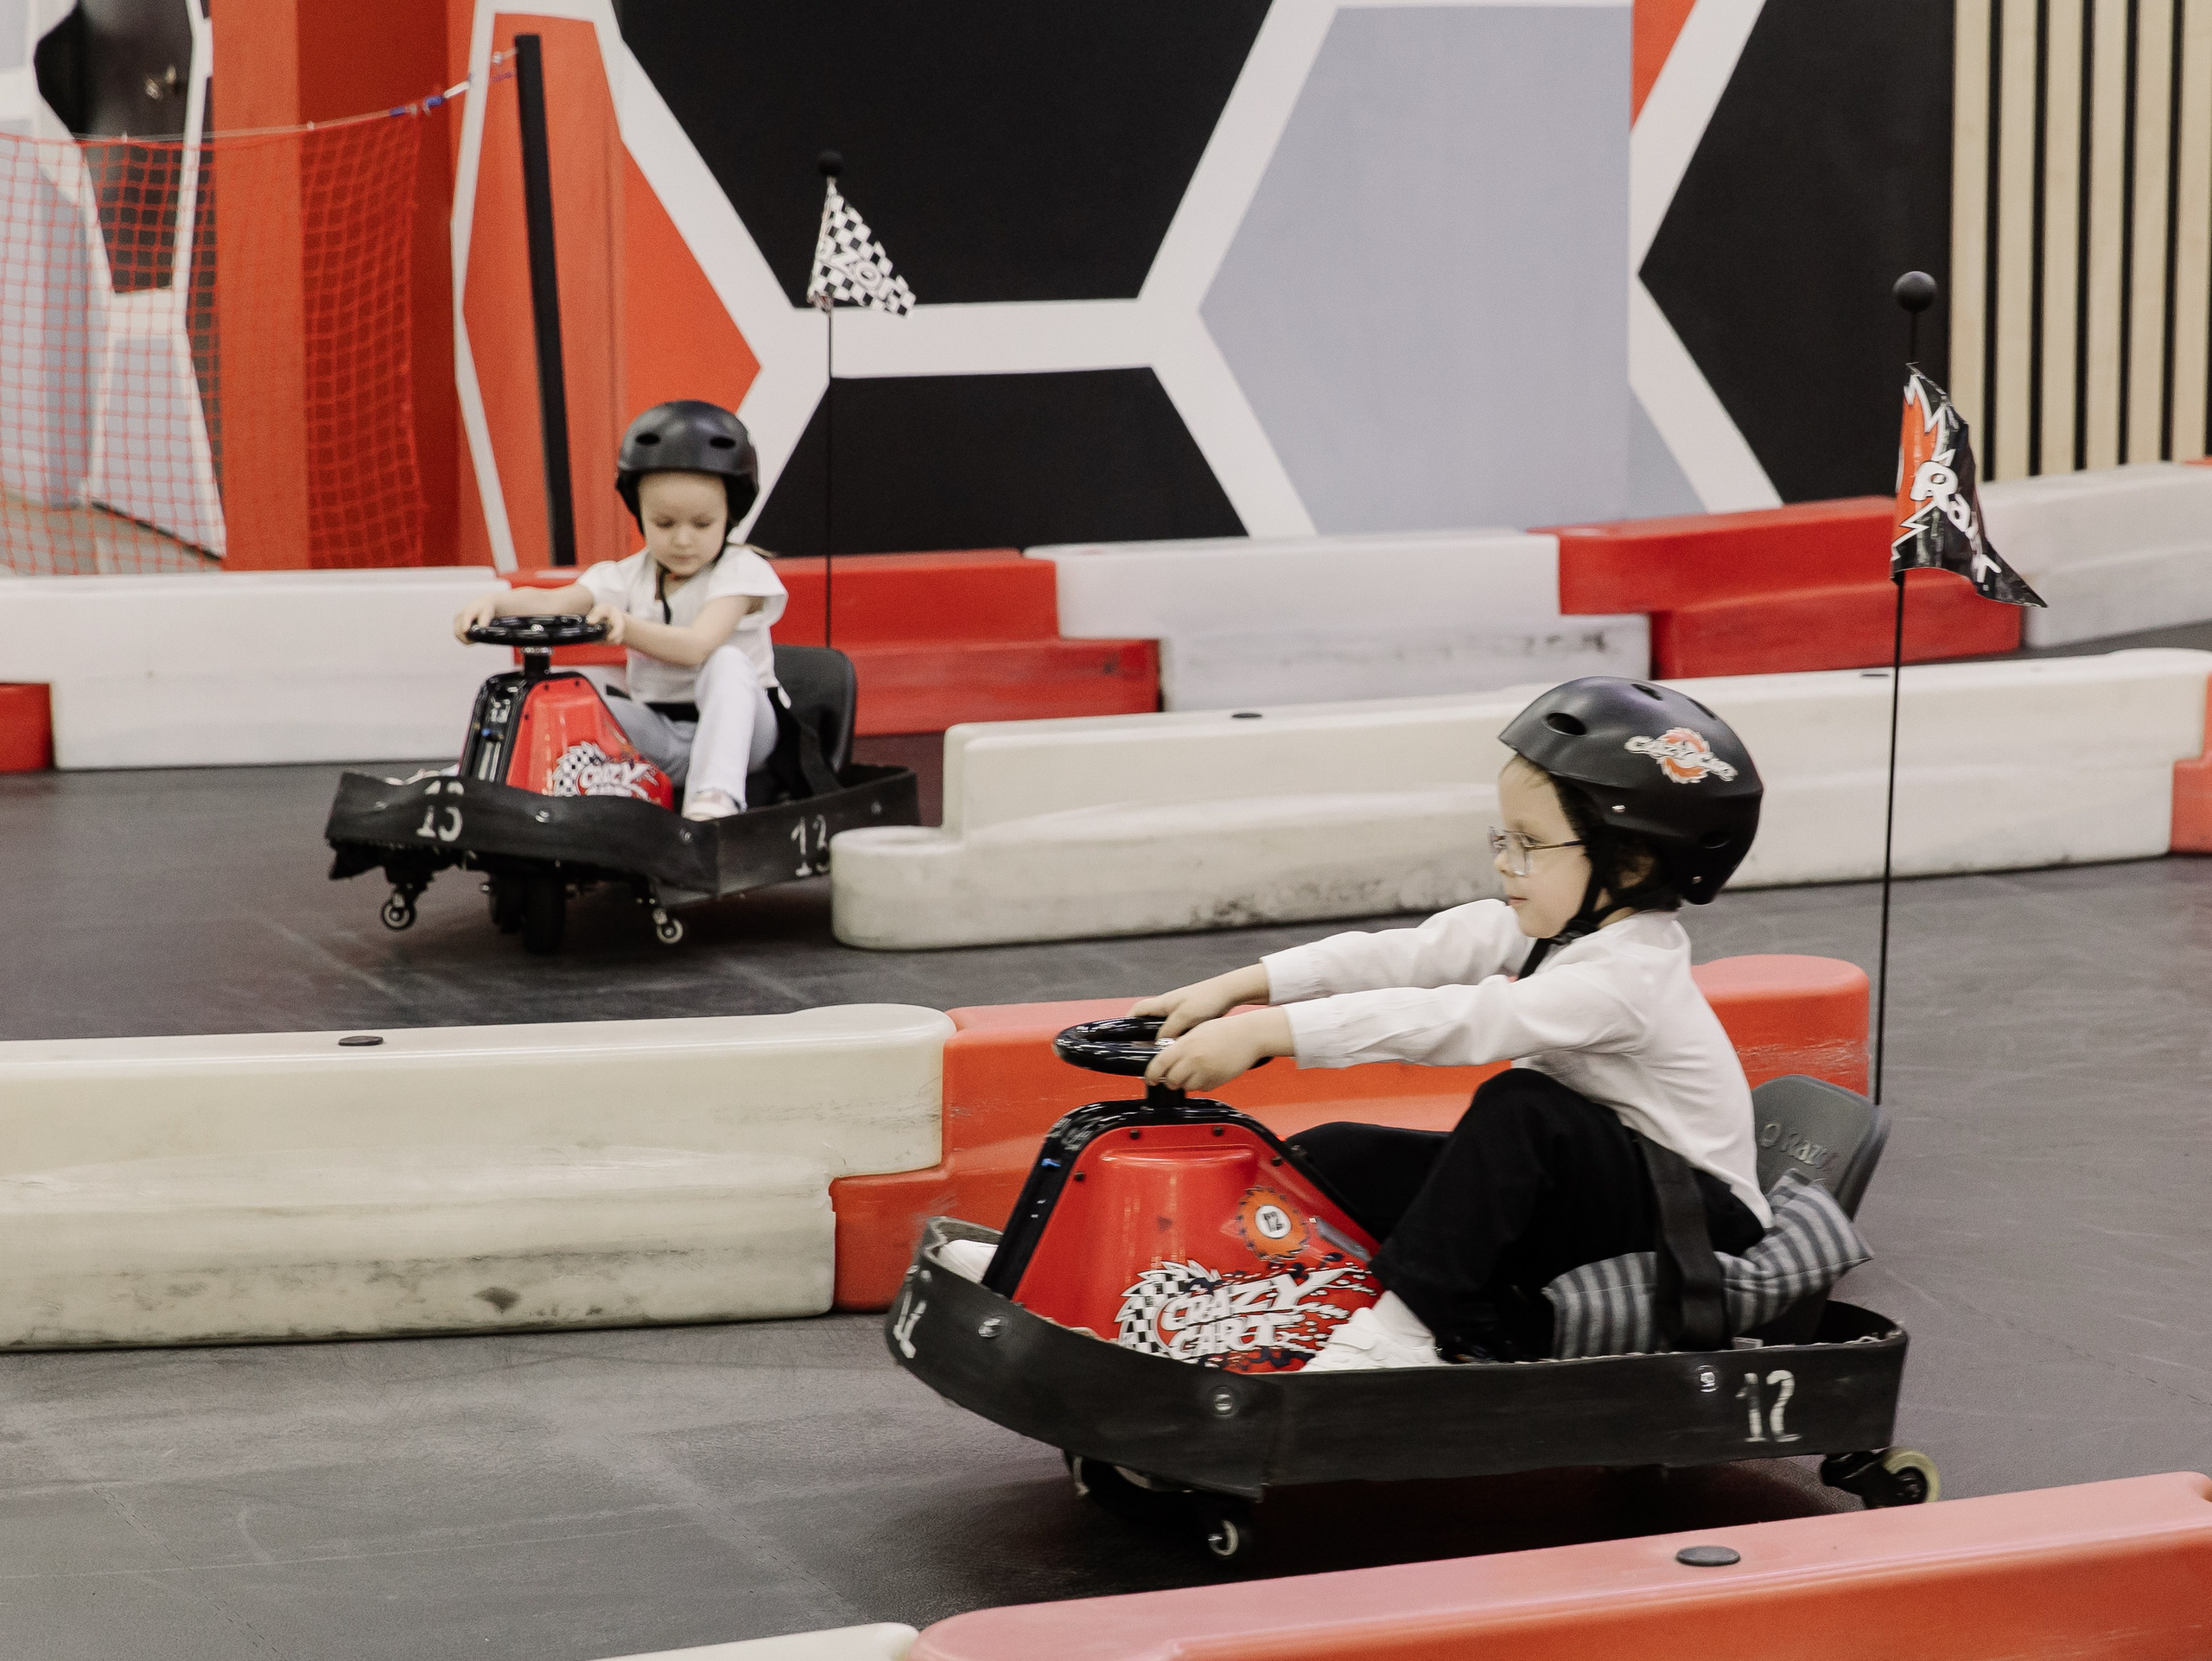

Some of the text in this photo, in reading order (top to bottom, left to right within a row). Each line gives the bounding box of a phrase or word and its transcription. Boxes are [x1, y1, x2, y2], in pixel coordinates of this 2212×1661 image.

[1160, 1267, 1352, 1331] CRAZY
[1167, 1313, 1300, 1359] CART
[1735, 1370, 1803, 1443] 12
